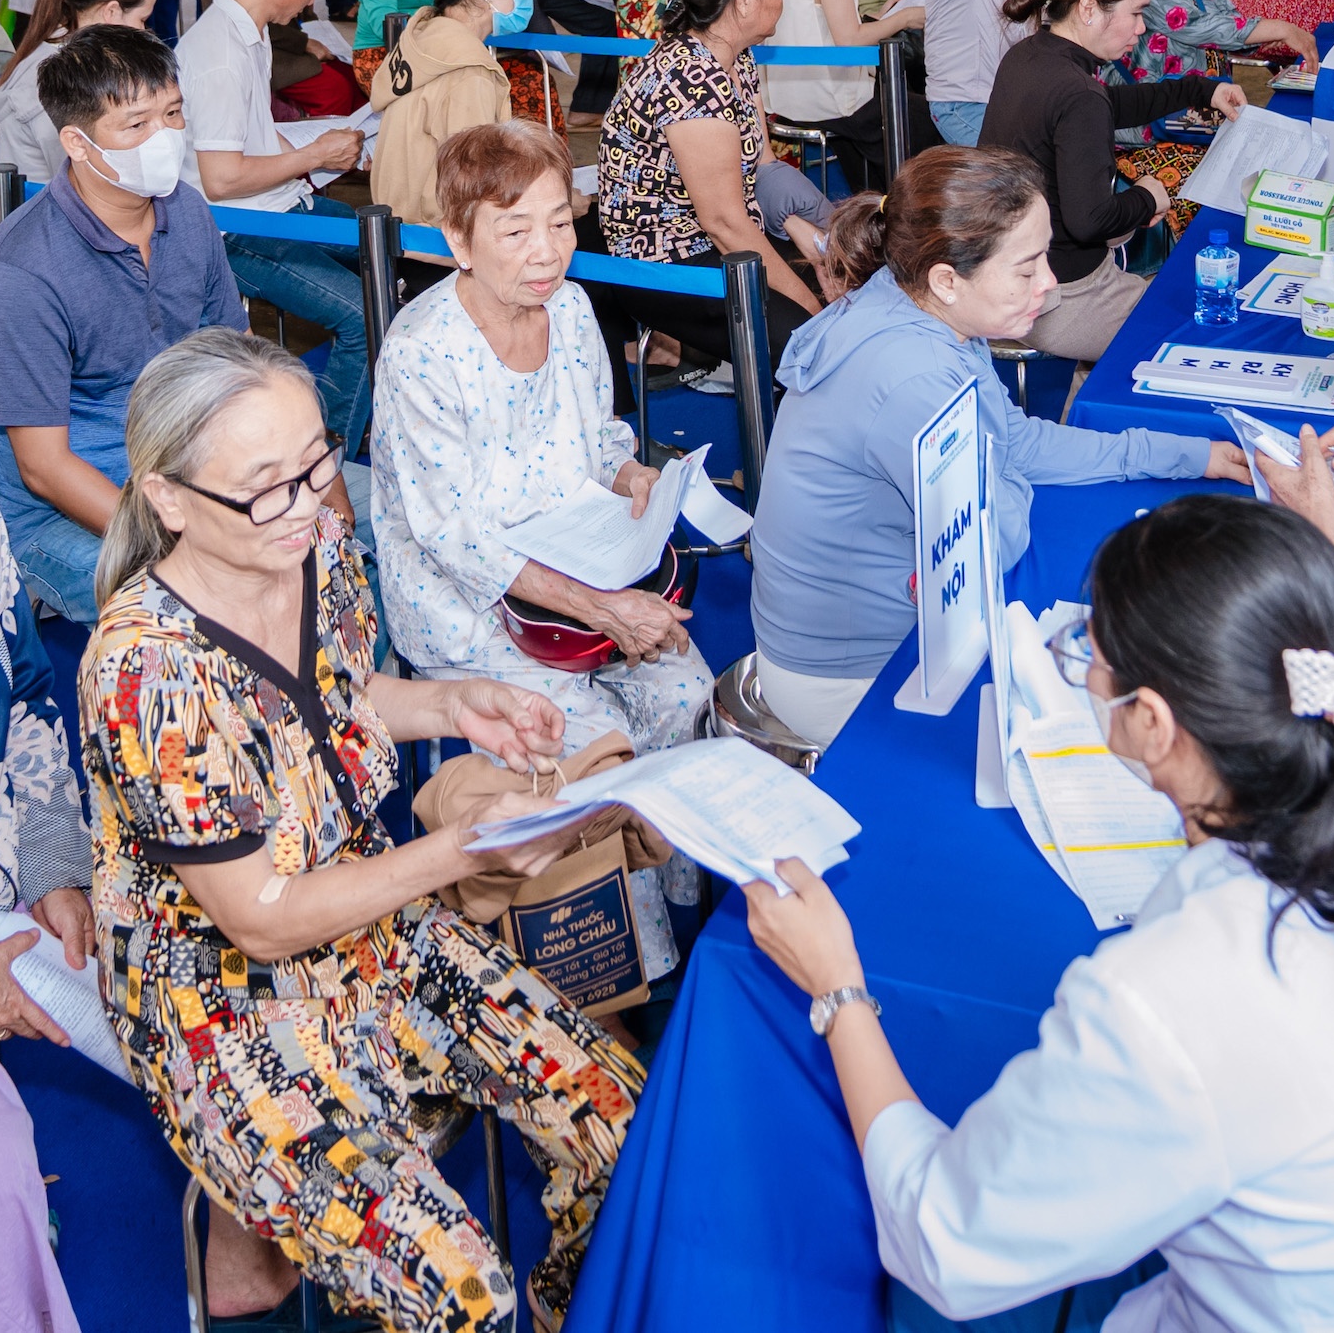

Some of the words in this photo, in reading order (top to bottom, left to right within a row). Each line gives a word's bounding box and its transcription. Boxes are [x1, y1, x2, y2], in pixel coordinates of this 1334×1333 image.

[1260, 189, 1295, 203] DEPRESSOR
[1297, 197, 1324, 208] TONGUE
[1274, 282, 1304, 305] HỌNG
[932, 501, 971, 571] KHÁM
[942, 561, 965, 613] NỘI
[535, 937, 576, 960] LONG
[579, 919, 616, 944] CHÂU
[543, 926, 567, 942] NHÀ
[569, 910, 604, 934] THUỐC
[561, 970, 589, 986] Hàng
[591, 960, 609, 974] Tận
[611, 952, 626, 966] Nơi
[566, 960, 580, 972] Tốt
[593, 948, 609, 961] Giá
[611, 941, 626, 954] Tốt
[587, 983, 616, 1000] 6928
